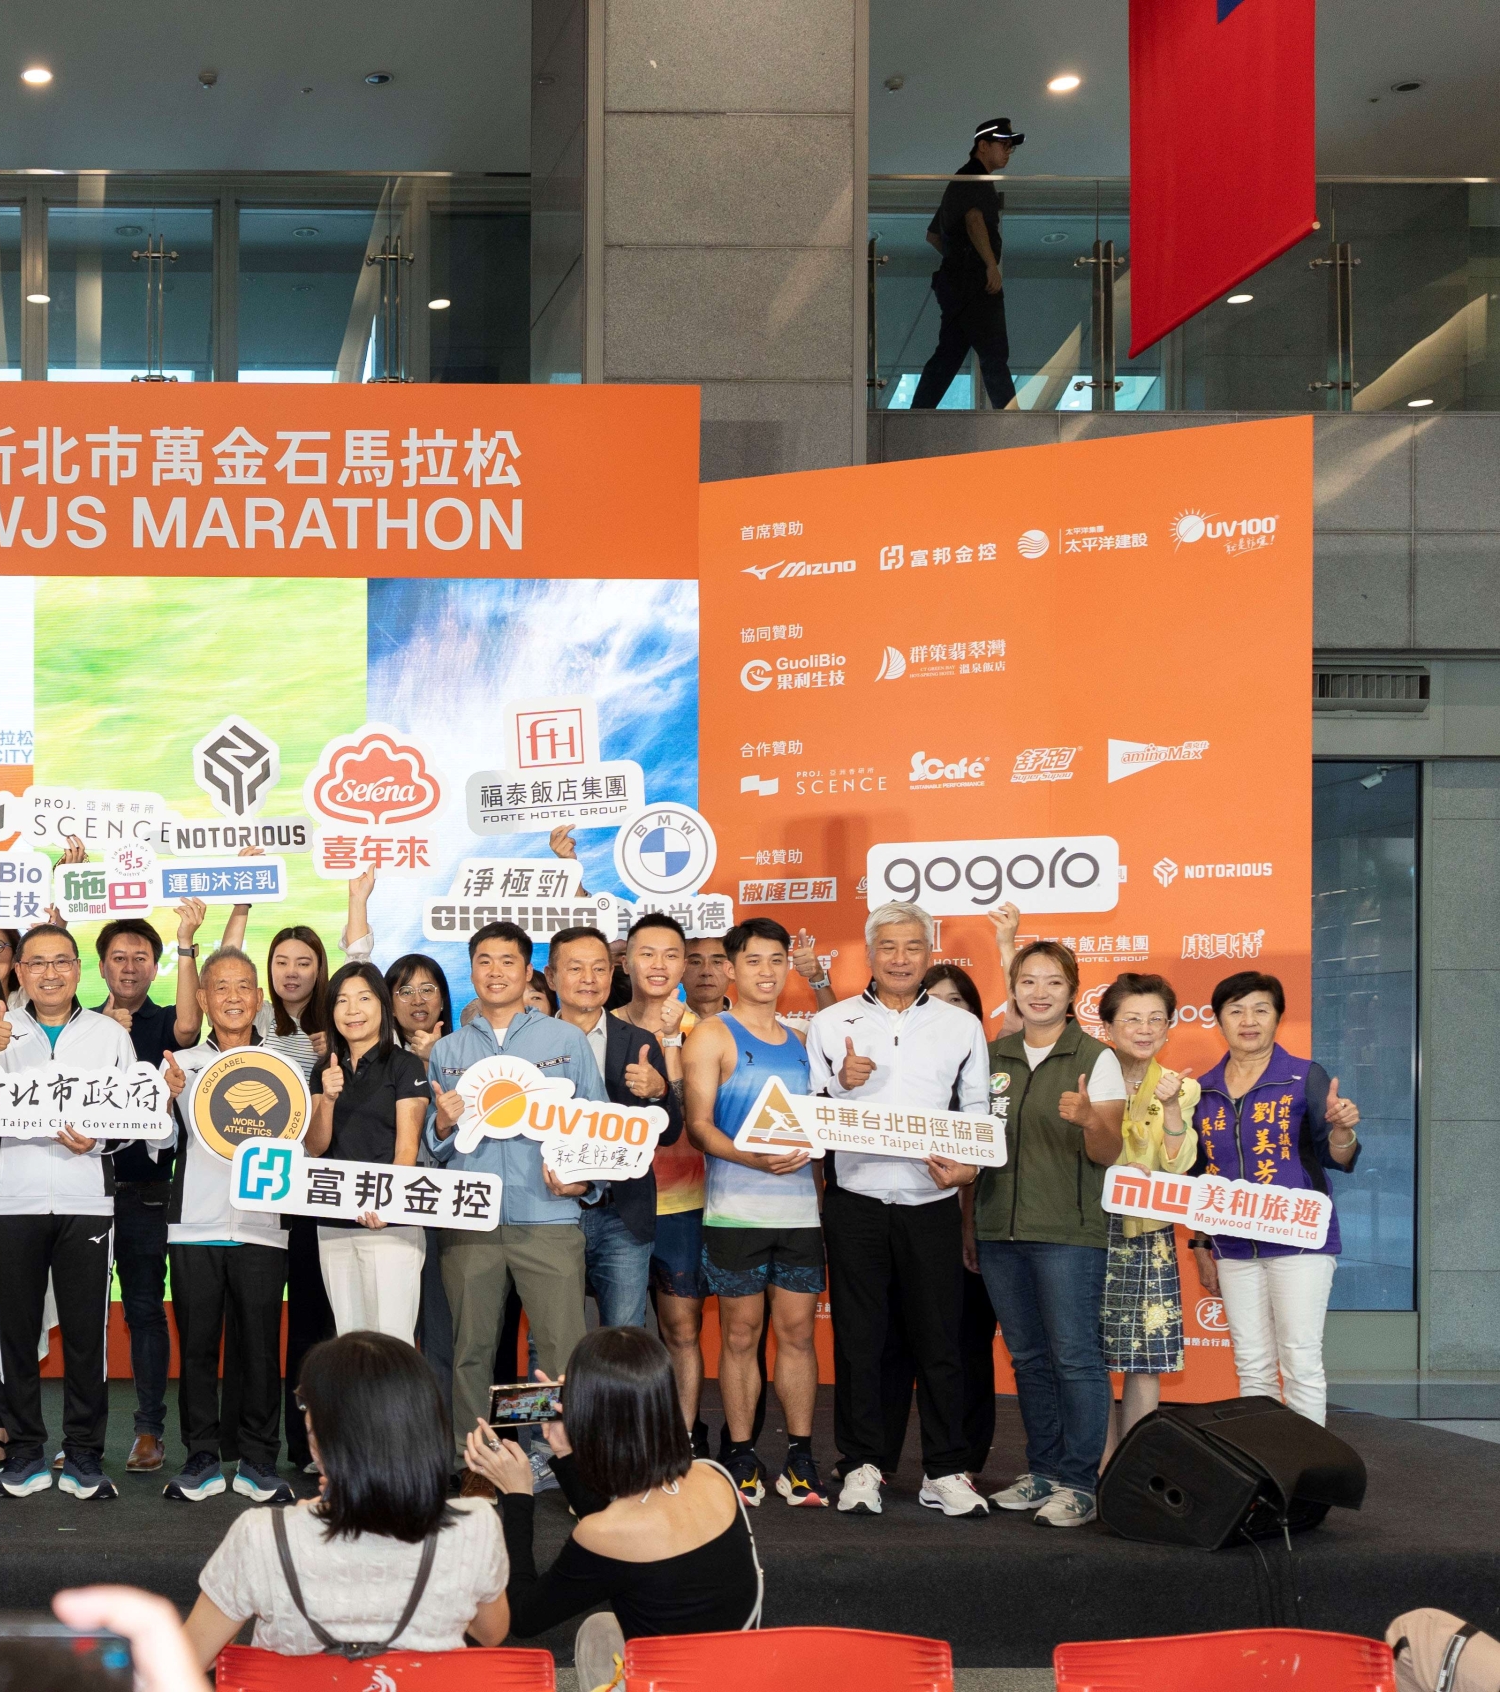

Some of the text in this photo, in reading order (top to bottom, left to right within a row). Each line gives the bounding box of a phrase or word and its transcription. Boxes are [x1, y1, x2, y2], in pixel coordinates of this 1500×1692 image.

[131, 497, 524, 551] MARATHON
[740, 520, 804, 541] 首席贊助
[1206, 516, 1276, 539] UV100
[910, 543, 997, 568] 富邦金控
[1065, 532, 1148, 554] 太平洋建設
[740, 623, 803, 643] 協同贊助
[776, 653, 847, 671] GuoliBio
[909, 639, 1007, 664] 群策翡翠灣
[776, 670, 846, 691] 果利生技
[959, 661, 1006, 675] 溫泉飯店
[740, 740, 803, 758] 合作贊助
[1013, 747, 1076, 773] 舒跑
[796, 770, 823, 778] PROJ.
[796, 776, 887, 796] SCENCE
[909, 780, 985, 791] SUSTAINABLE PERFORMANCE
[338, 775, 416, 805] Serena
[480, 774, 627, 809] 福泰飯店集團
[34, 797, 77, 810] PROJ.
[482, 804, 628, 824] FORTE HOTEL GROUP
[33, 814, 172, 844] SCENCE
[177, 823, 306, 850] NOTORIOUS
[634, 814, 698, 839] BMW
[118, 850, 133, 863] pH
[124, 857, 143, 871] 5.5
[322, 835, 431, 870] 喜年來
[739, 848, 803, 866] 一般贊助
[168, 868, 276, 894] 運動沐浴乳
[463, 867, 570, 898] 淨極勁
[883, 847, 1100, 905] gogoro
[1184, 862, 1273, 879] NOTORIOUS
[742, 880, 833, 902] 撒隆巴斯
[68, 902, 107, 914] sebamed
[1181, 930, 1263, 960] 康貝特
[933, 957, 973, 967] HOTEL
[202, 1057, 246, 1094] GOLD LABEL
[0, 1117, 43, 1130] Taipei
[48, 1117, 76, 1129] City
[81, 1118, 163, 1130] Government
[223, 1125, 272, 1137] ATHLETICS
[232, 1117, 266, 1128] WORLD
[288, 1110, 302, 1135] 2026
[528, 1101, 650, 1146] UV100
[815, 1105, 994, 1142] 中華台北田徑協會
[1214, 1106, 1227, 1131] 主任
[1277, 1094, 1294, 1161] 新北市議員
[817, 1128, 996, 1159] Chinese Taipei Athletics
[1251, 1101, 1278, 1184] 劉美芳
[306, 1166, 492, 1220] 富邦金控
[1196, 1183, 1322, 1228] 美和旅遊
[1194, 1212, 1318, 1241] Maywood Travel Ltd
